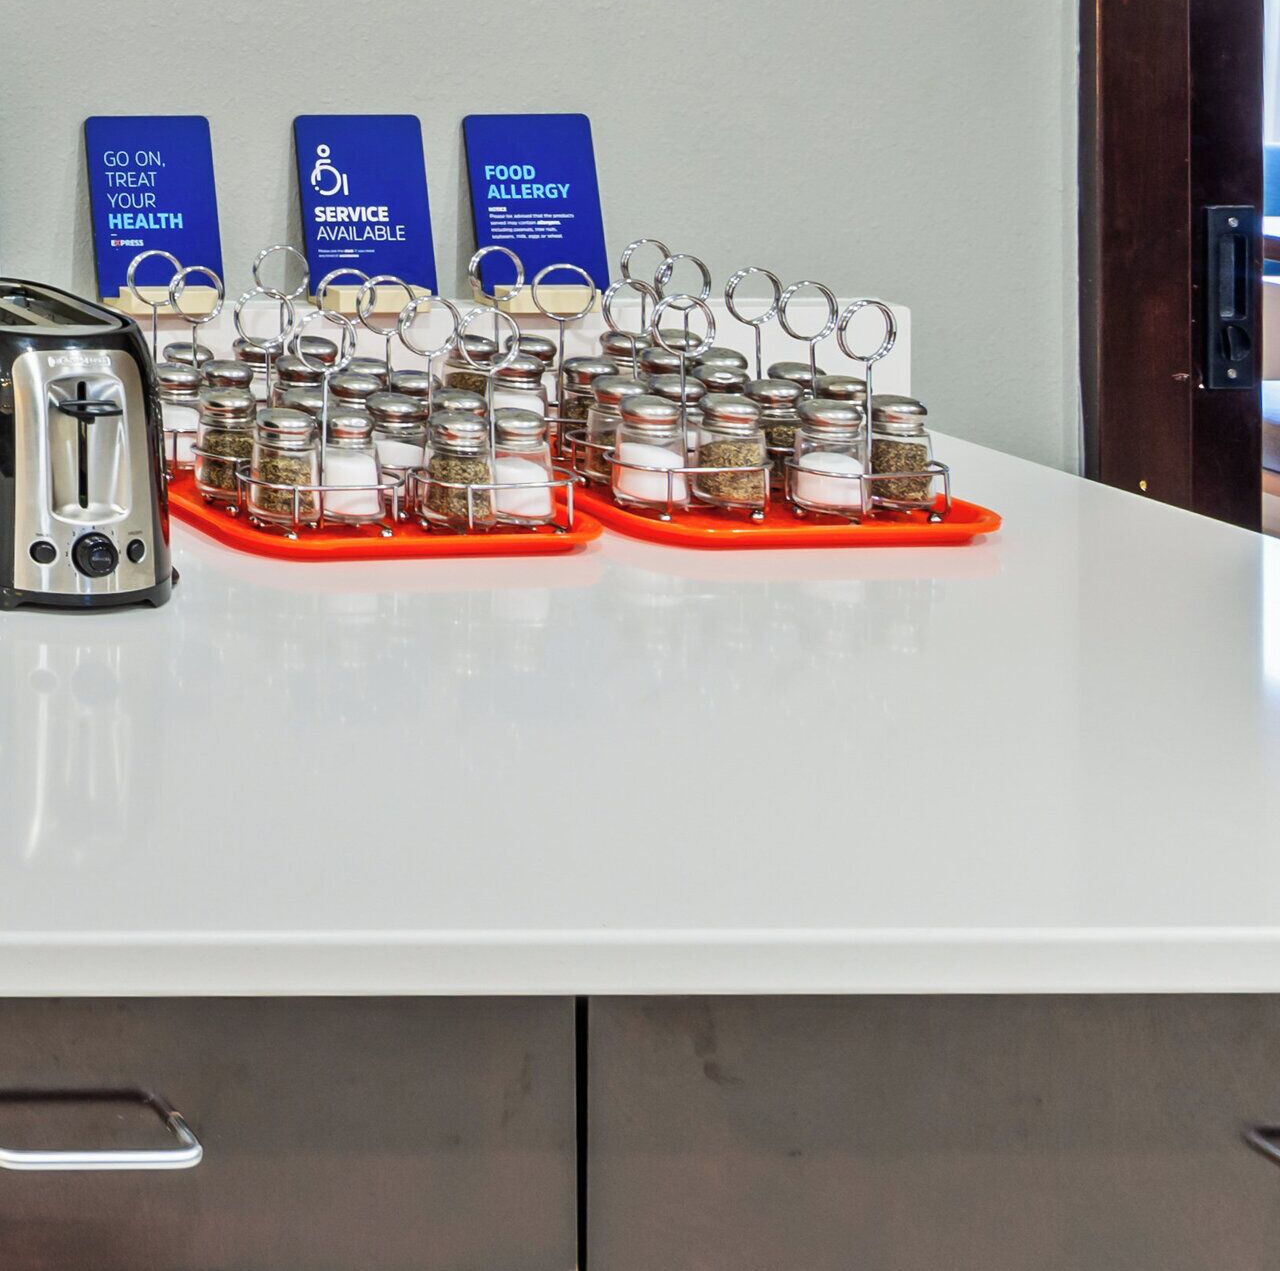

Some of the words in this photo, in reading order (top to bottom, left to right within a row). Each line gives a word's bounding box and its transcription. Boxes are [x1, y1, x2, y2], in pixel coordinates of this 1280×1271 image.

[103, 150, 130, 167] GO
[134, 150, 166, 168] ON,
[105, 171, 157, 188] TREAT
[484, 165, 536, 181] FOOD
[487, 183, 571, 199] ALLERGY
[107, 192, 157, 209] YOUR
[108, 213, 184, 230] HEALTH
[314, 206, 390, 222] SERVICE
[316, 225, 406, 241] AVAILABLE
